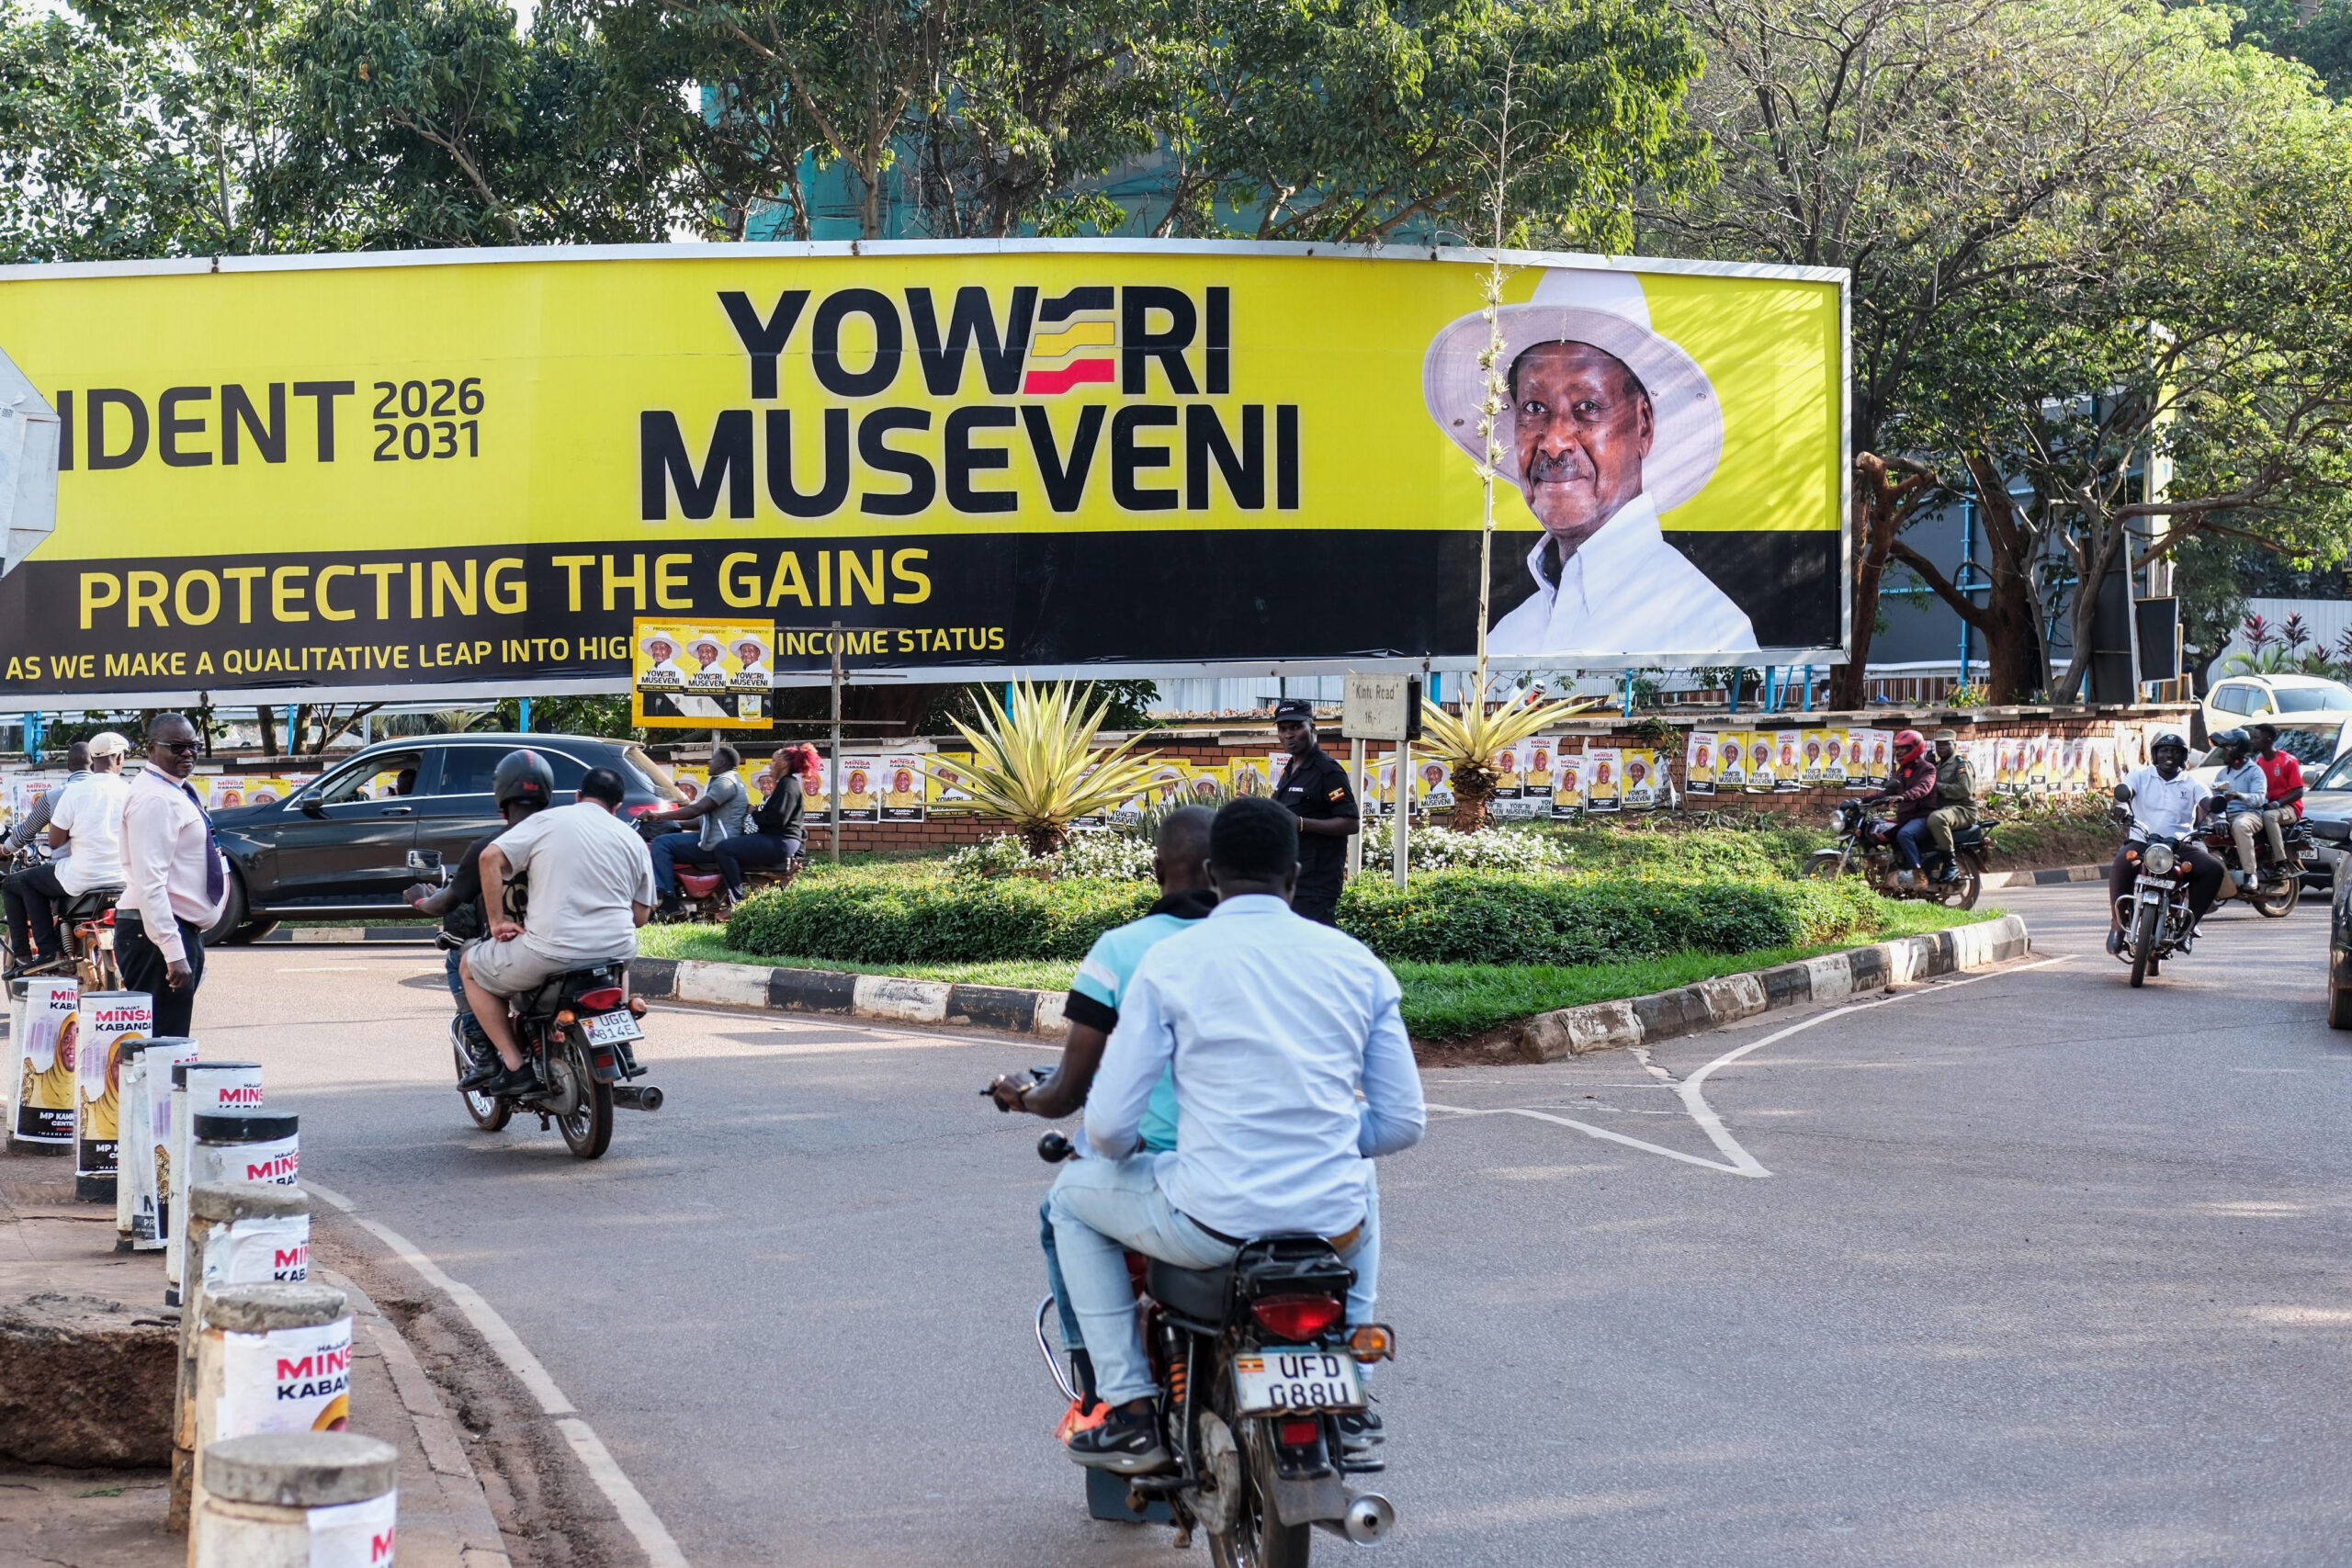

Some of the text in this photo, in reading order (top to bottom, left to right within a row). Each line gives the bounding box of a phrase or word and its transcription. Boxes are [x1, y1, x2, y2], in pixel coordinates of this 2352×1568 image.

[718, 286, 1230, 400] YOWERI
[374, 377, 484, 421] 2026
[373, 419, 479, 462] 2031
[640, 404, 1299, 521] MUSEVENI
[79, 547, 932, 630] PROTECTING THE GAINS
[6, 626, 1005, 680] AS WE MAKE A QUALITATIVE LEAP INTO HIG INCOME STATUS
[641, 676, 680, 684] MUSEVENI
[646, 670, 676, 678] YOWERI
[693, 672, 722, 681] YOWERI
[735, 671, 764, 680] YOWERI
[688, 679, 726, 687] MUSEVENI
[730, 678, 768, 686] MUSEVENI
[1355, 684, 1373, 699] Kntu
[1420, 798, 1452, 807] MUSEVENI
[95, 1010, 152, 1022] MINSA
[599, 1012, 629, 1027] UGC
[95, 1021, 152, 1032] KABANDA
[598, 1024, 636, 1040] 814E
[40, 1111, 54, 1121] MP
[96, 1144, 112, 1153] MP
[1279, 1355, 1341, 1379] UFD
